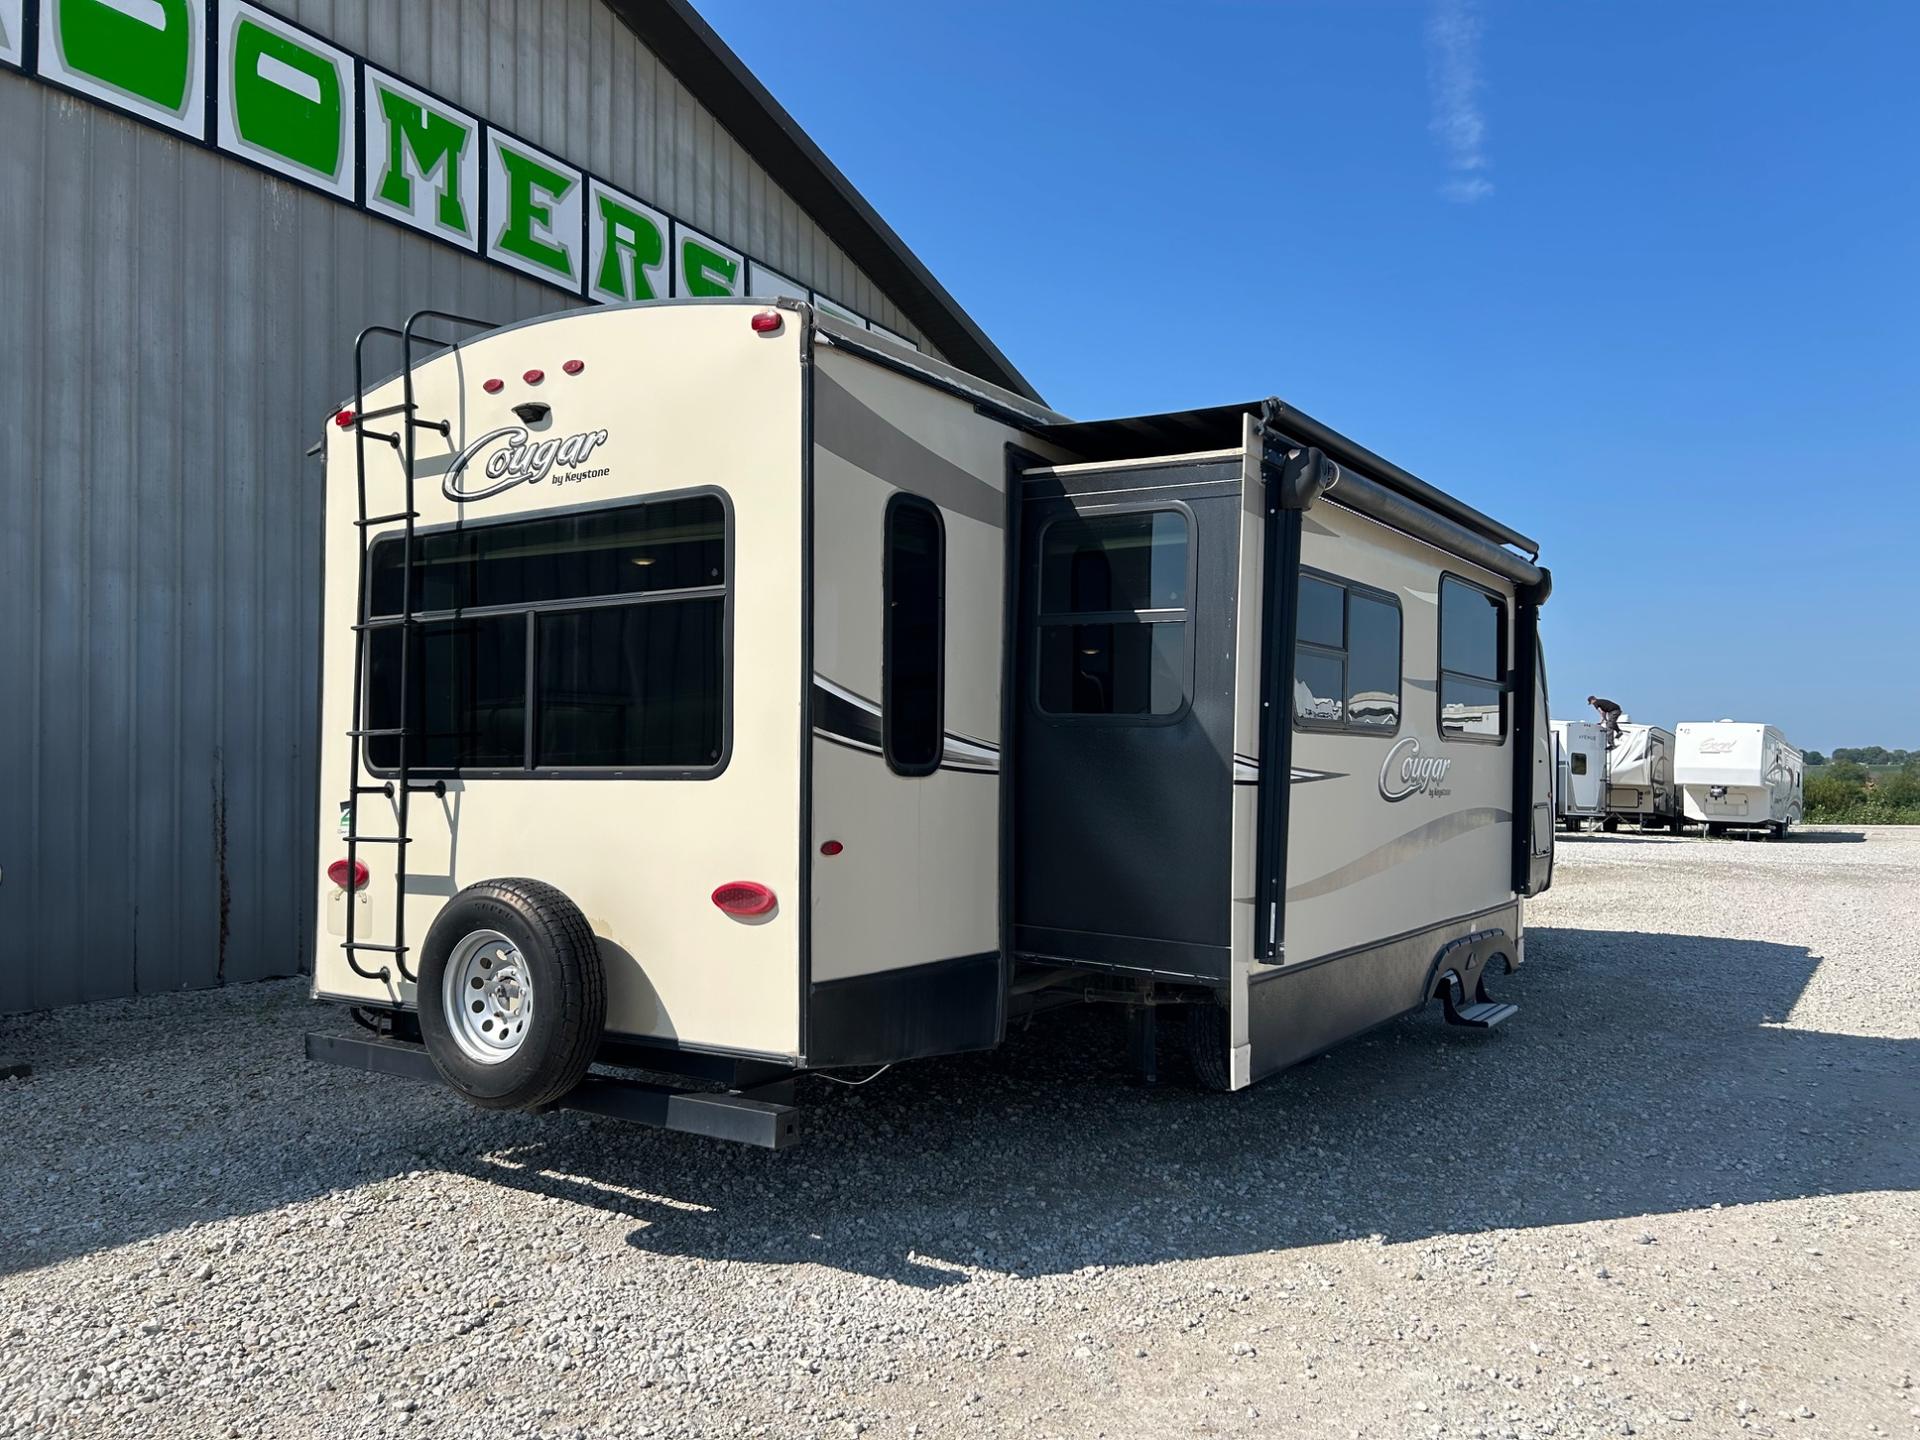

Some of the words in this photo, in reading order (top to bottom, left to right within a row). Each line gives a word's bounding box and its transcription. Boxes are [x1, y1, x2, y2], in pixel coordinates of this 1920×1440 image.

[0, 0, 742, 300] OOMERS
[442, 426, 608, 502] Cougar
[552, 474, 563, 486] by
[565, 468, 610, 483] Keystone
[1378, 736, 1451, 803] Cougar
